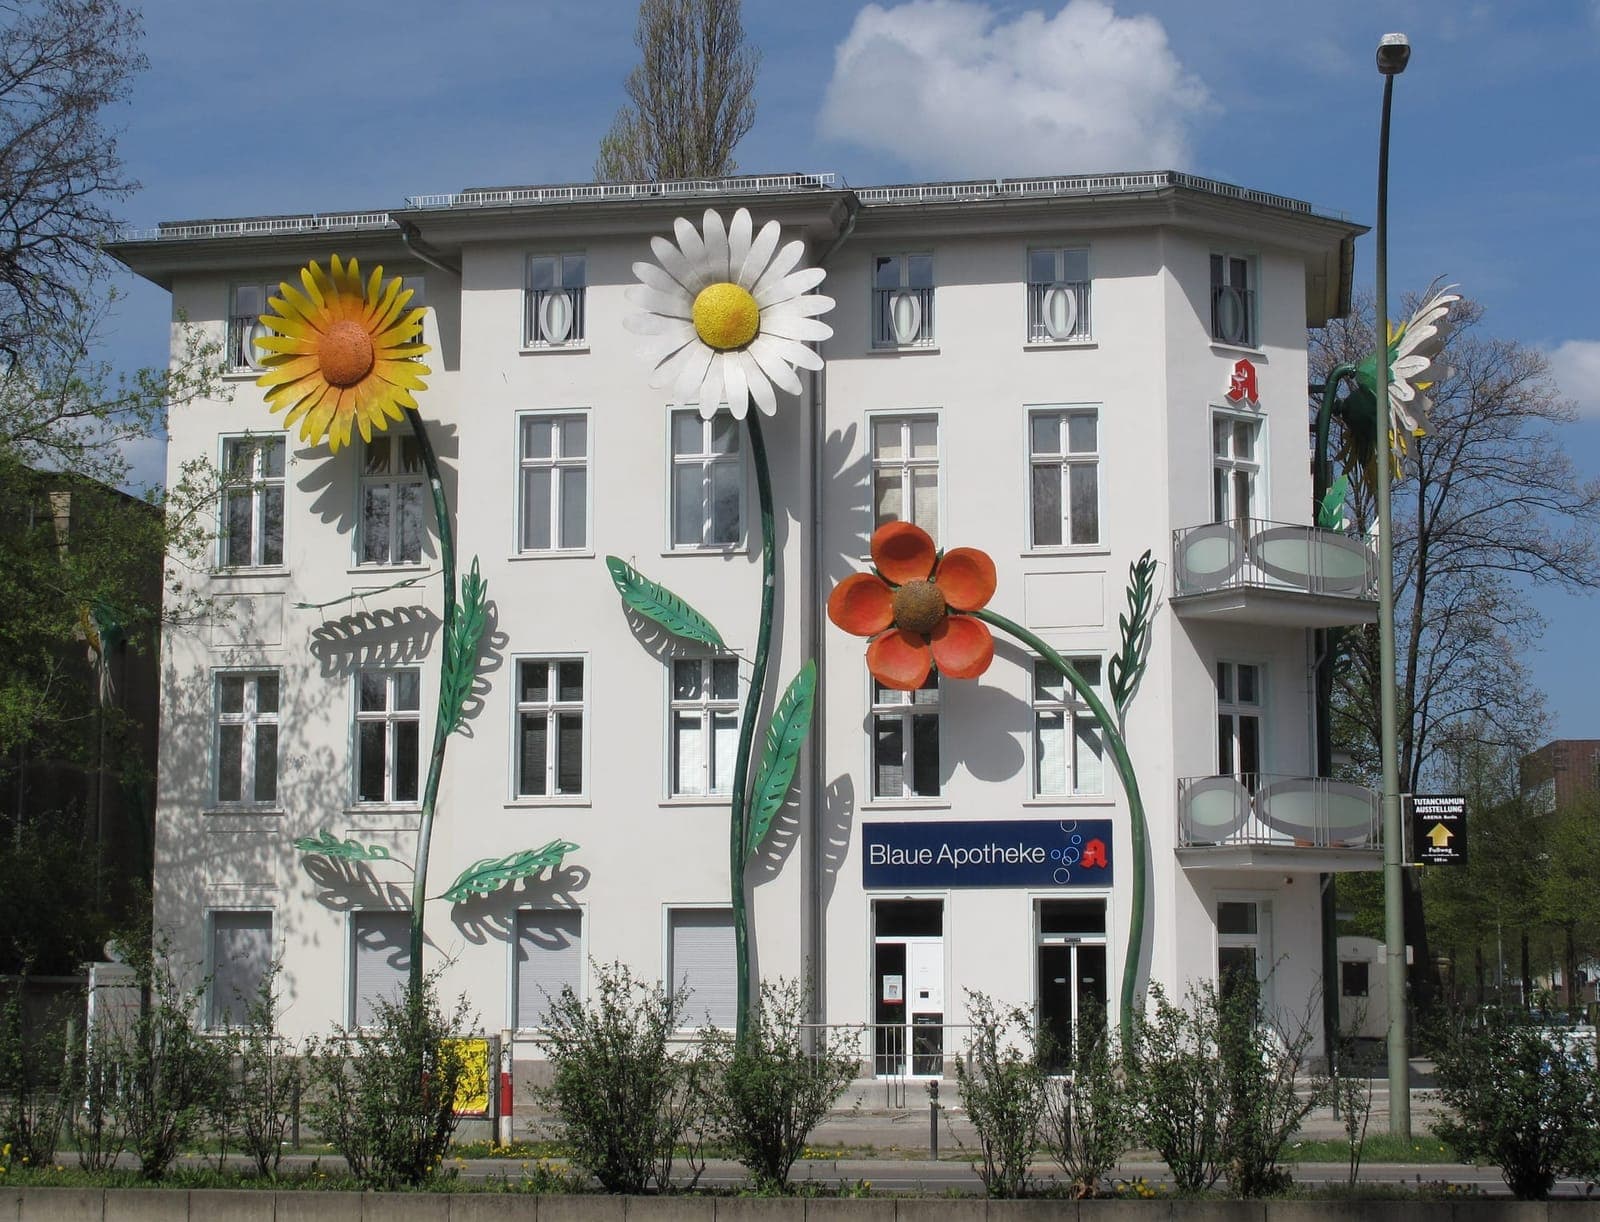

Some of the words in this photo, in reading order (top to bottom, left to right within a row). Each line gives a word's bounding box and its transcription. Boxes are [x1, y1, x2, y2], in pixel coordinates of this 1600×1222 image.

[1225, 358, 1259, 405] A
[870, 844, 932, 865] Blaue
[937, 843, 1045, 868] Apotheke
